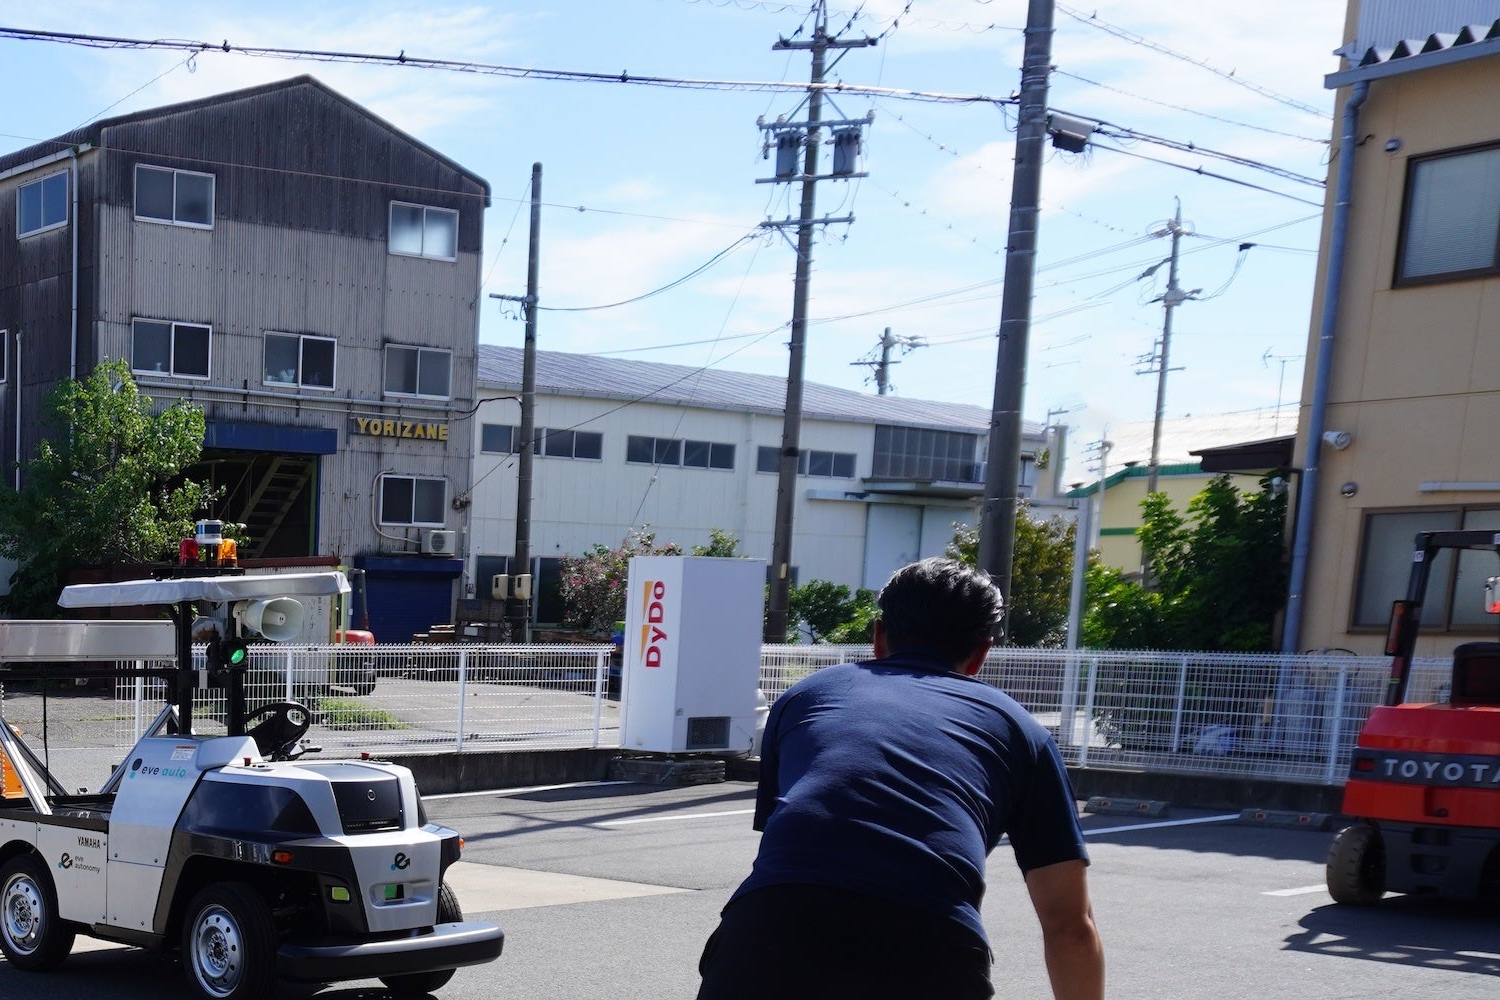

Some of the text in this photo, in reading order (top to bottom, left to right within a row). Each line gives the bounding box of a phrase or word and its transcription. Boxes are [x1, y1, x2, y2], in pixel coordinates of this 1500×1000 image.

[357, 417, 449, 441] YORIZANE
[646, 580, 668, 668] DyDo
[141, 766, 187, 779] eve auto
[78, 836, 100, 849] YAMAHA
[75, 855, 84, 863] eve
